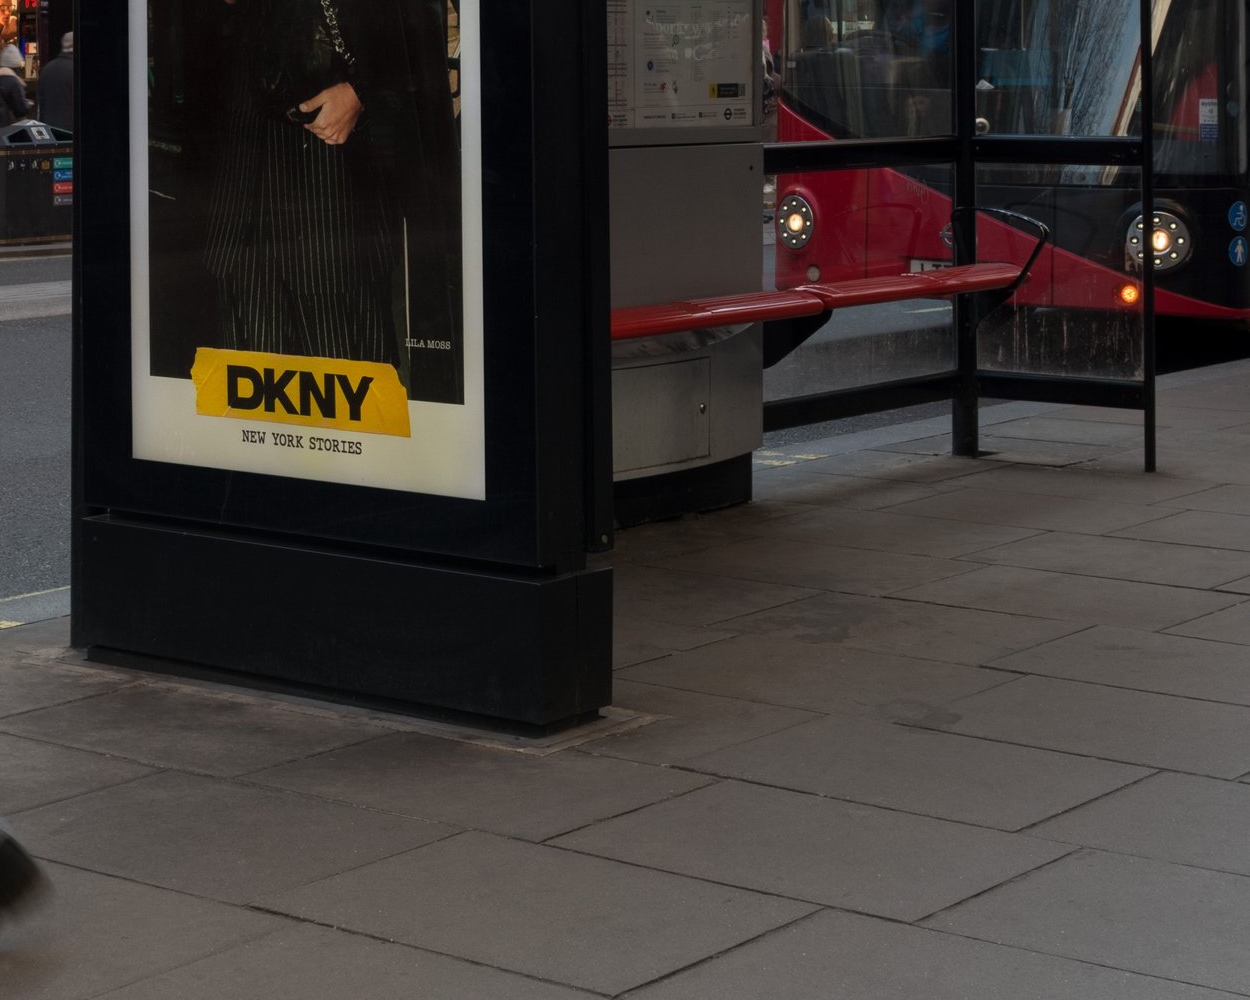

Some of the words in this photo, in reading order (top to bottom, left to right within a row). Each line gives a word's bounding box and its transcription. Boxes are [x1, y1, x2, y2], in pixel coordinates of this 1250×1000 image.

[405, 337, 426, 349] LILA
[427, 339, 451, 351] MOSS
[226, 364, 375, 422] DKNY
[241, 429, 267, 446] NEW
[271, 433, 304, 449] YORK
[308, 437, 363, 456] STORIES
